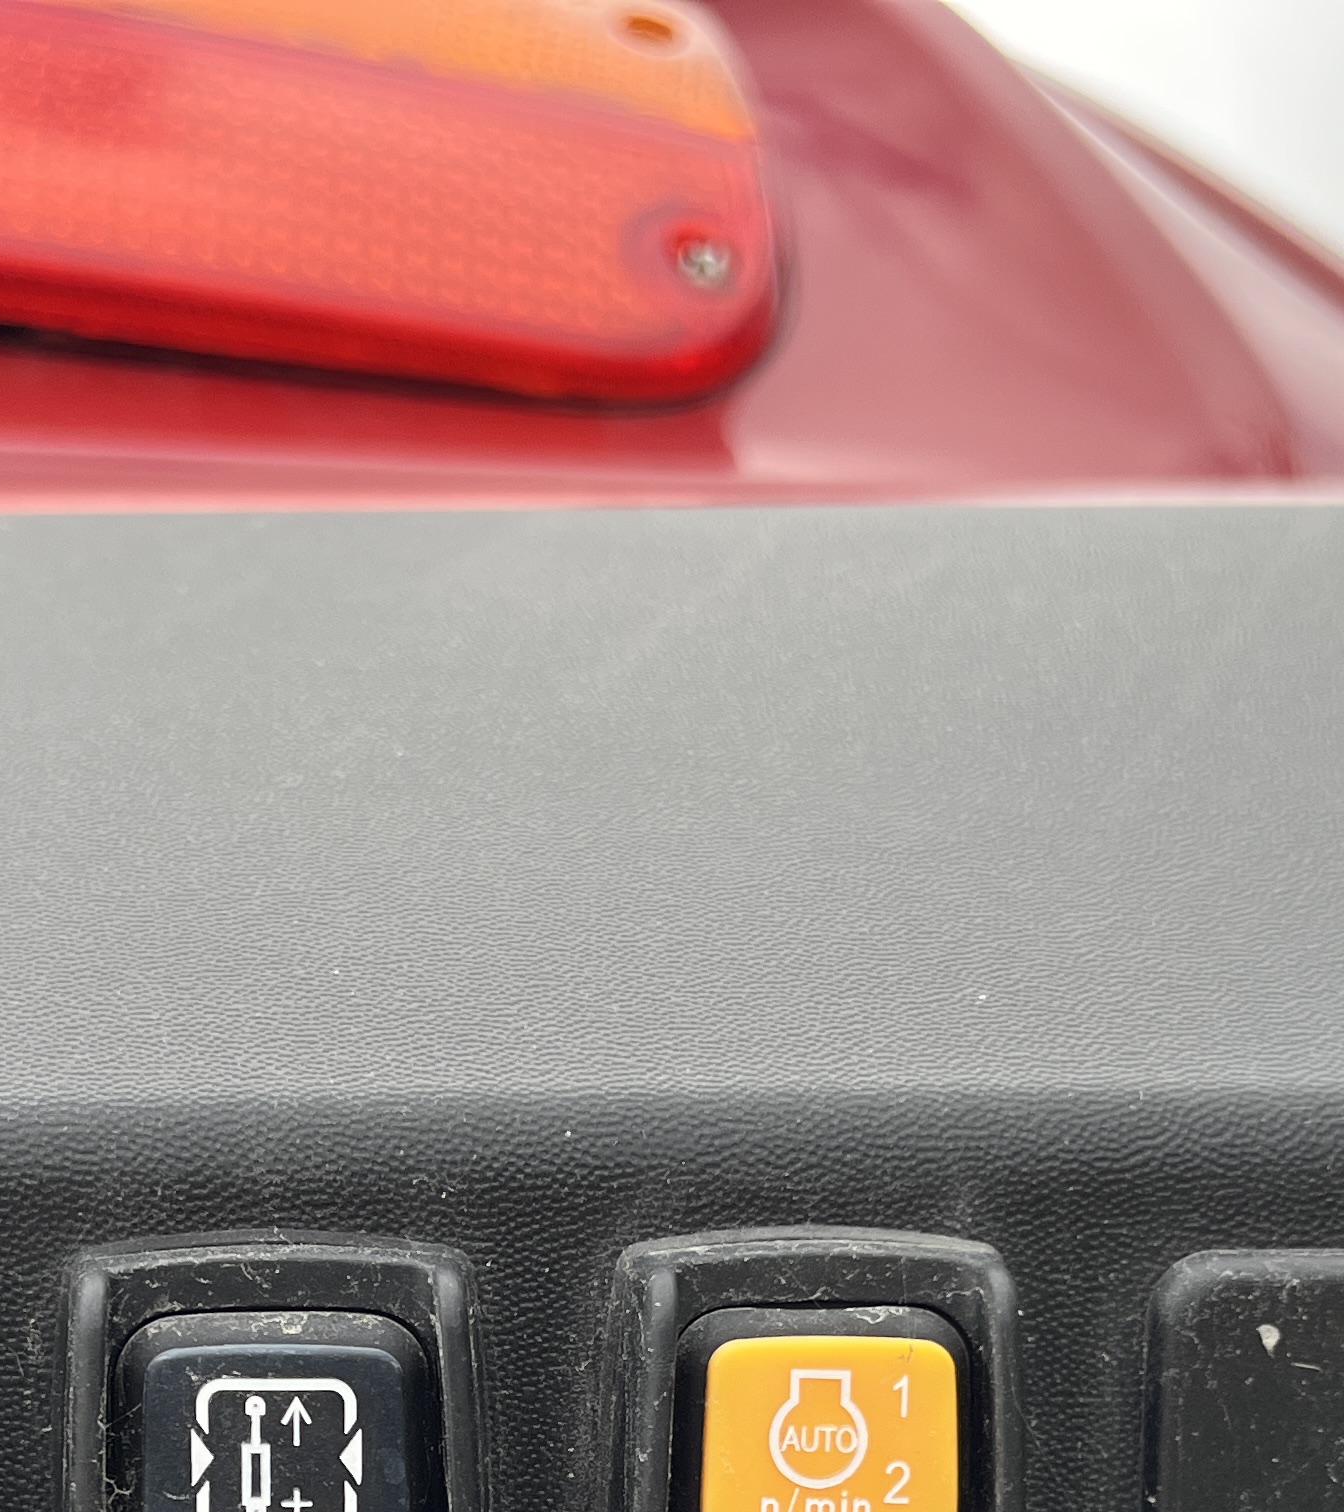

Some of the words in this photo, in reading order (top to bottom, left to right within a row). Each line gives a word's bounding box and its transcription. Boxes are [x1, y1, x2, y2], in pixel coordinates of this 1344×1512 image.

[892, 1374, 909, 1418] 1
[779, 1426, 858, 1453] AUTO
[883, 1460, 911, 1505] 2
